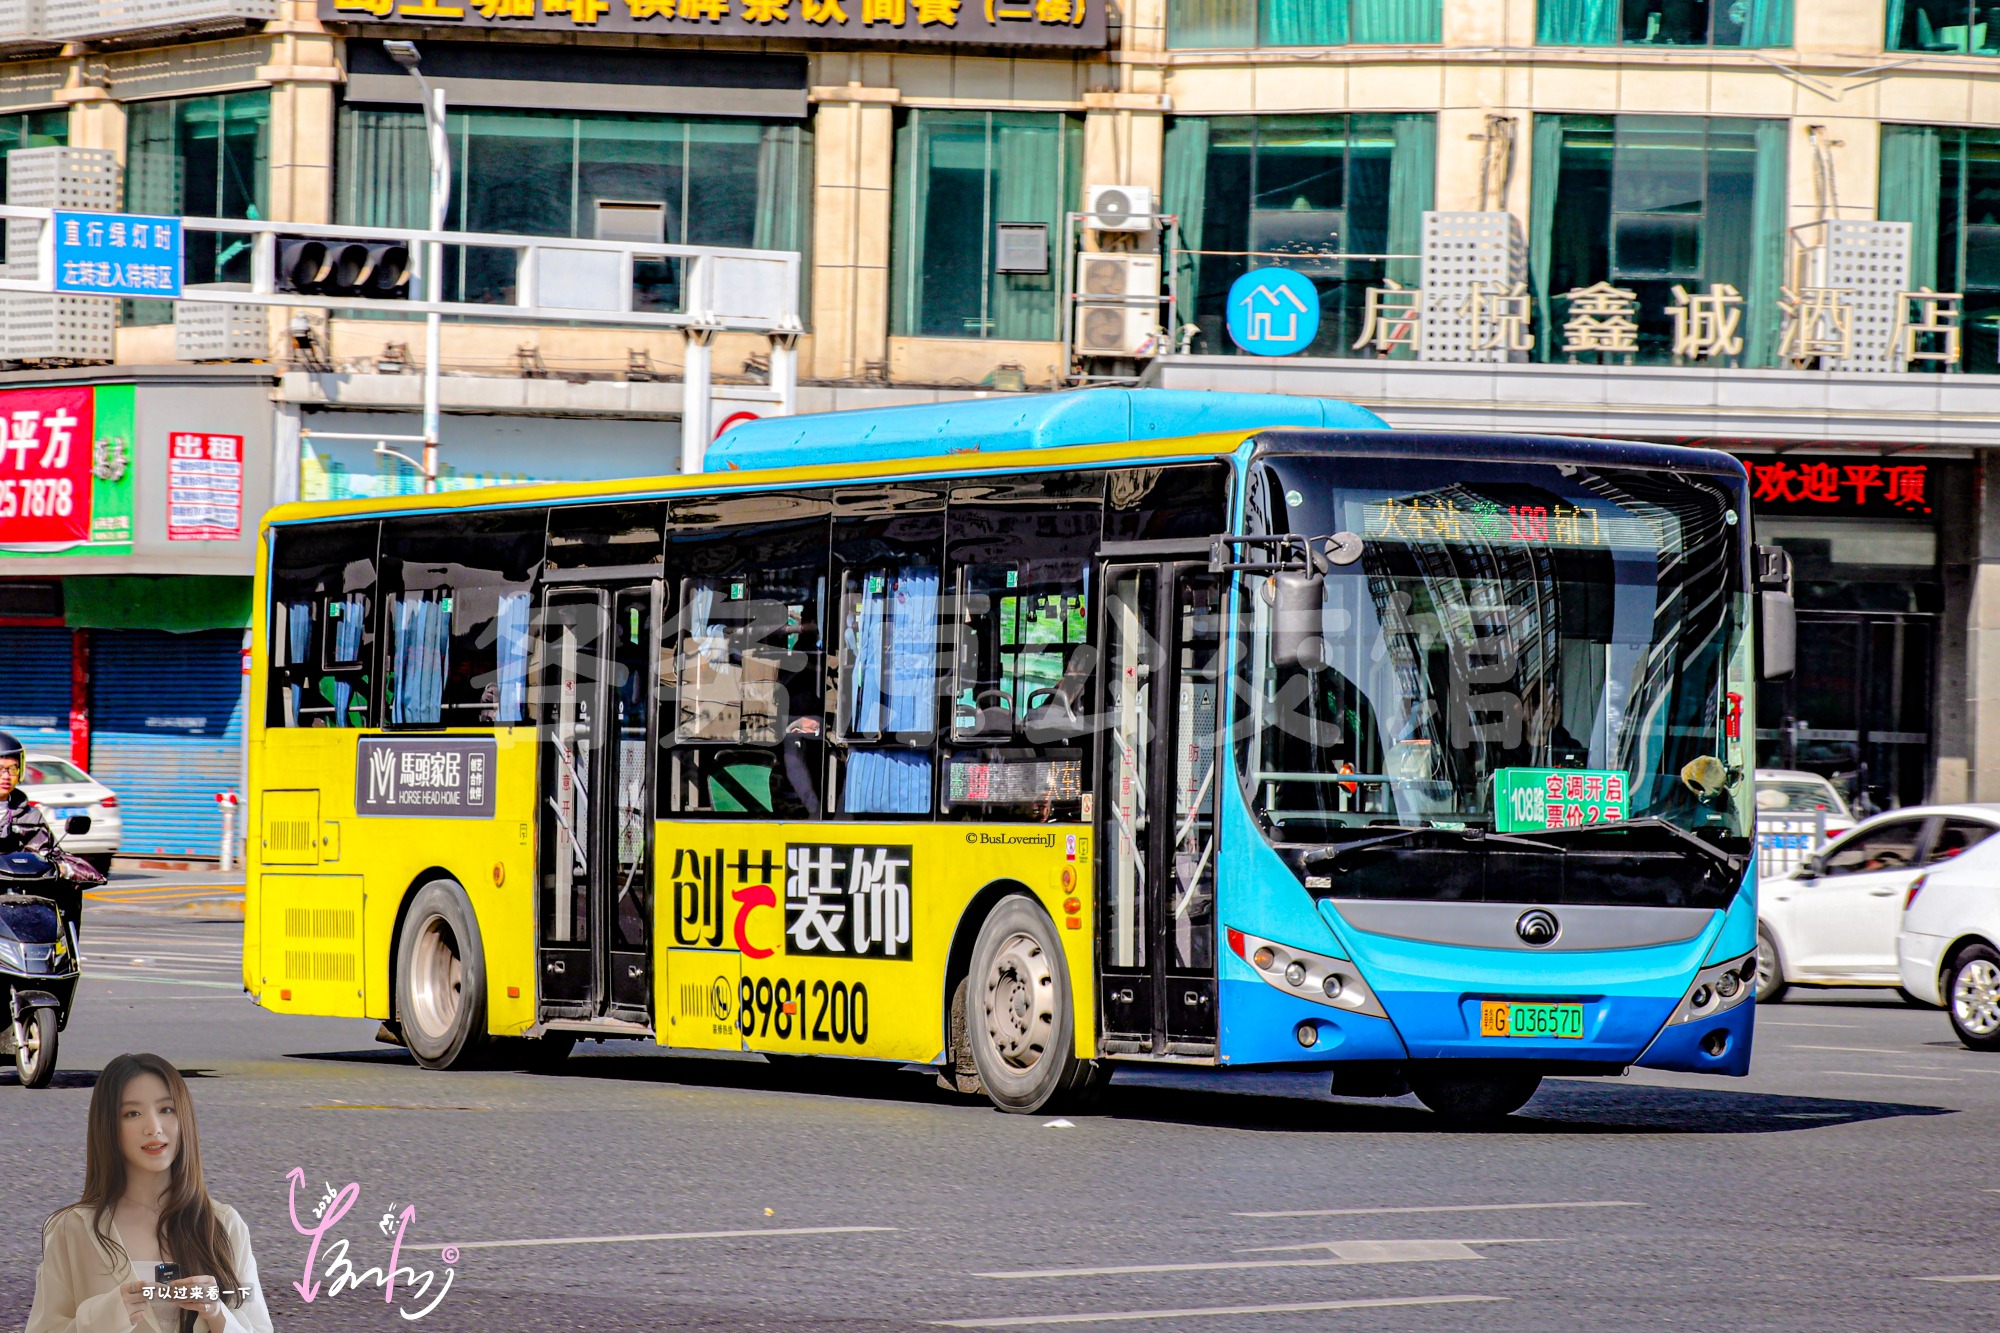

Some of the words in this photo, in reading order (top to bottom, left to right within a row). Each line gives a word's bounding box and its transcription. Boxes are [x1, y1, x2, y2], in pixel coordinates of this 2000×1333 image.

[63, 219, 172, 250] 直行绿灯时
[63, 260, 173, 289] 左转进入待转区
[1353, 279, 1964, 365] 启悦鑫诚酒店
[174, 434, 238, 460] 出租
[1379, 498, 1461, 540] 火车站
[1507, 505, 1549, 541] 108
[400, 752, 461, 788] 馬頭家居
[399, 790, 421, 804] HORSE
[422, 791, 440, 805] HEAD
[441, 791, 461, 805] HOME
[1546, 773, 1622, 802] 空调开启
[1511, 787, 1544, 823] 108路
[1546, 804, 1622, 829] 票价2元
[738, 976, 868, 1045] 8981200
